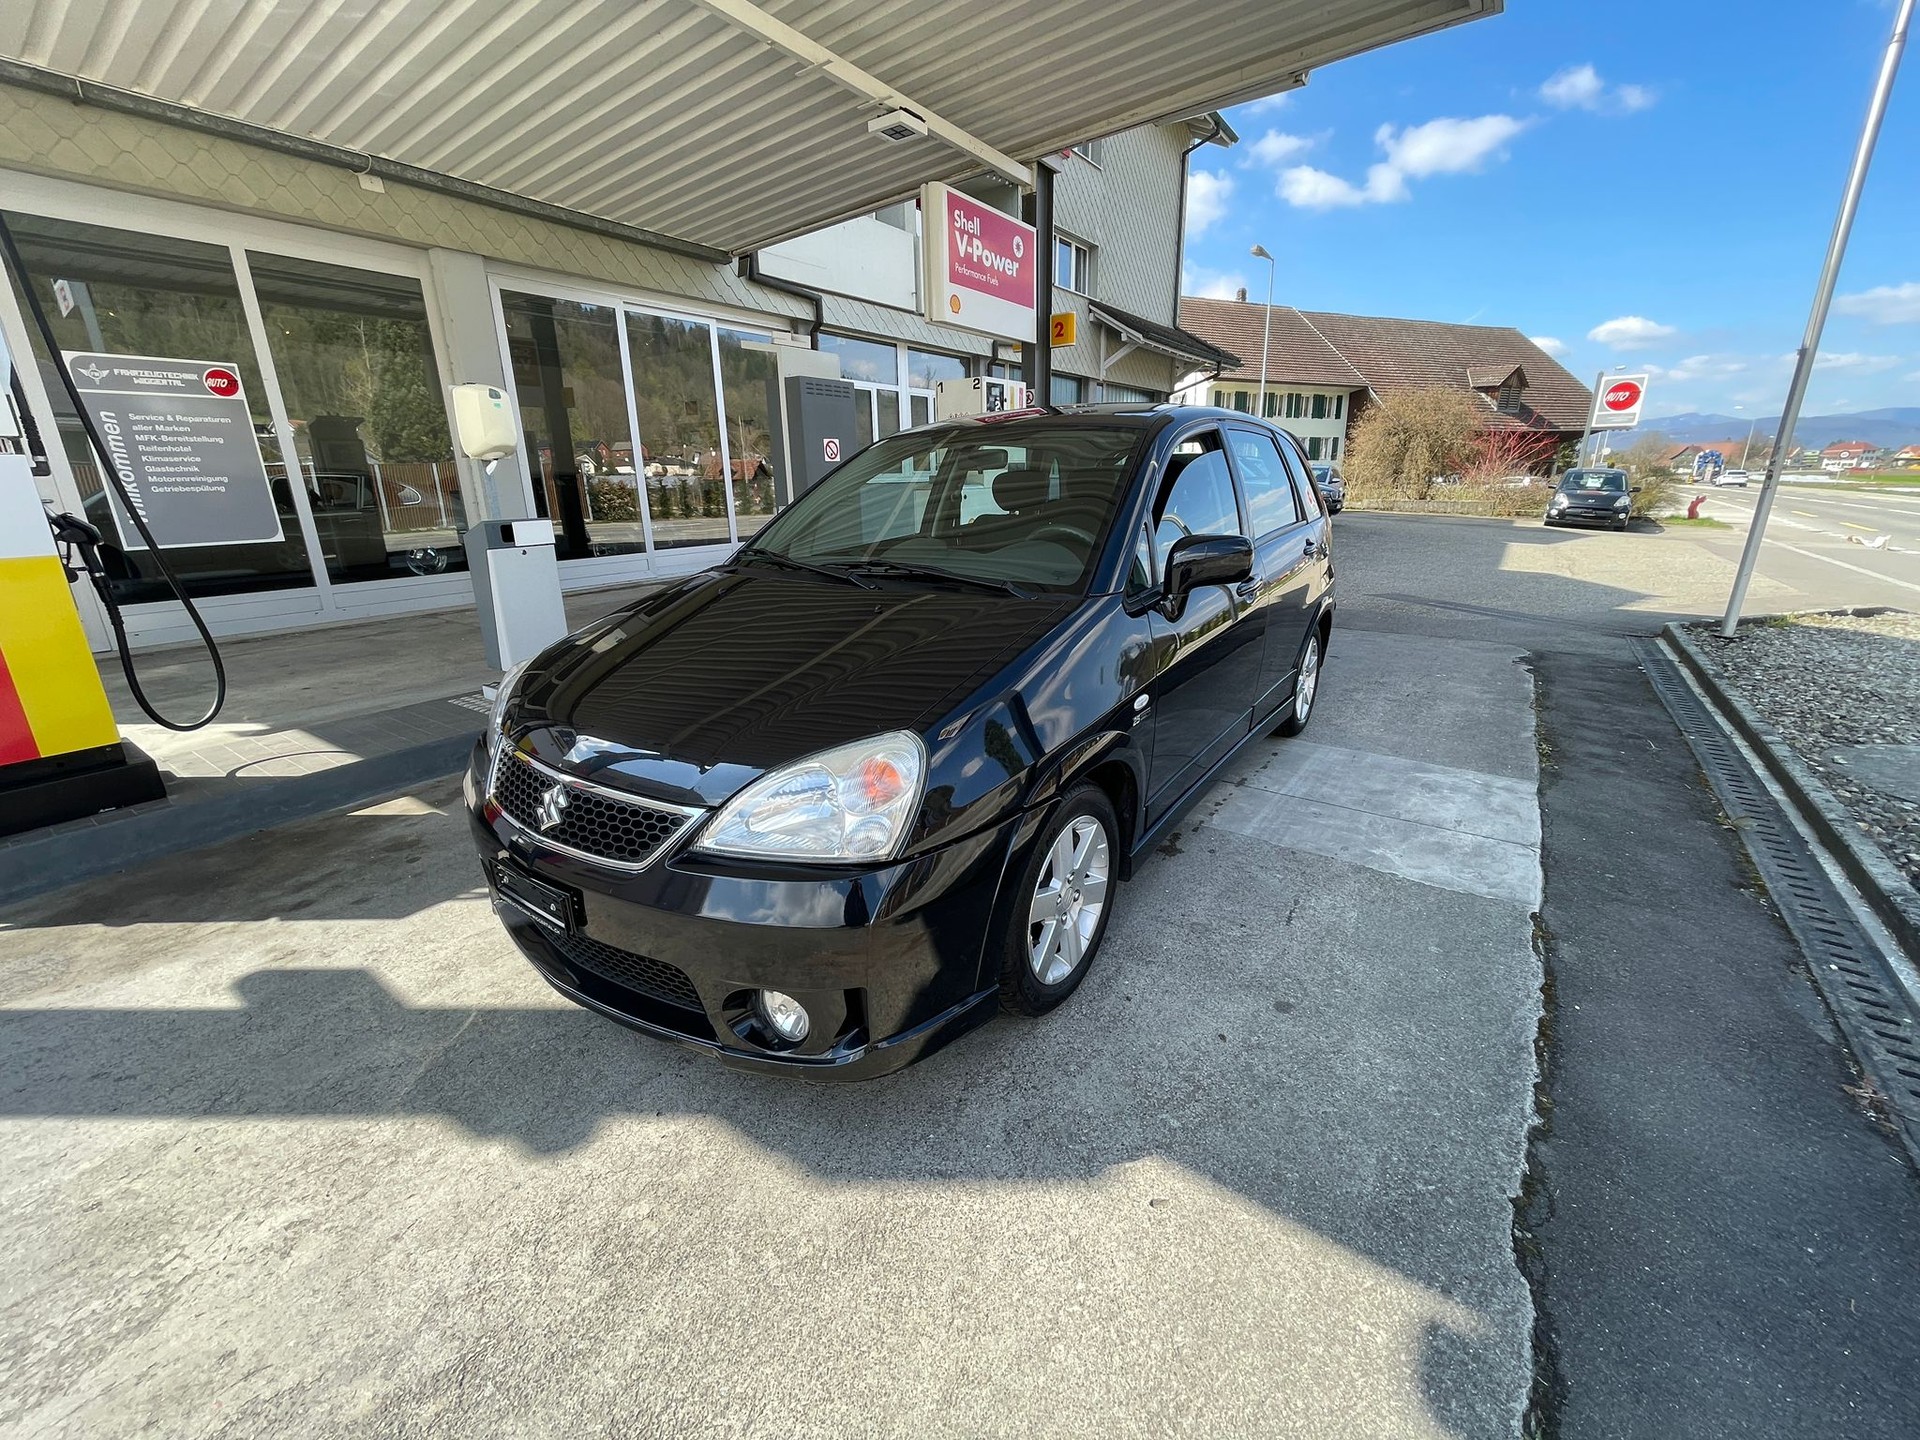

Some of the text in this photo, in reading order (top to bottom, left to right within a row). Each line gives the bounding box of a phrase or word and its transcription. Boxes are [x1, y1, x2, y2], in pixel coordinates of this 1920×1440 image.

[954, 209, 980, 236] Shell
[954, 231, 1019, 277] V-Power
[954, 262, 999, 287] Performance Fuels
[1054, 321, 1065, 338] 2
[937, 381, 944, 394] 1
[972, 377, 981, 390] 2
[129, 413, 232, 424] Service & Reparaturen
[133, 424, 153, 432] aller
[135, 434, 224, 444] MFK-Bereitstellung
[138, 444, 192, 452] Reifenhotel
[145, 465, 200, 473] Glastechnik
[148, 475, 229, 484] Motorenreinigung
[151, 485, 226, 493] Getriebespülung
